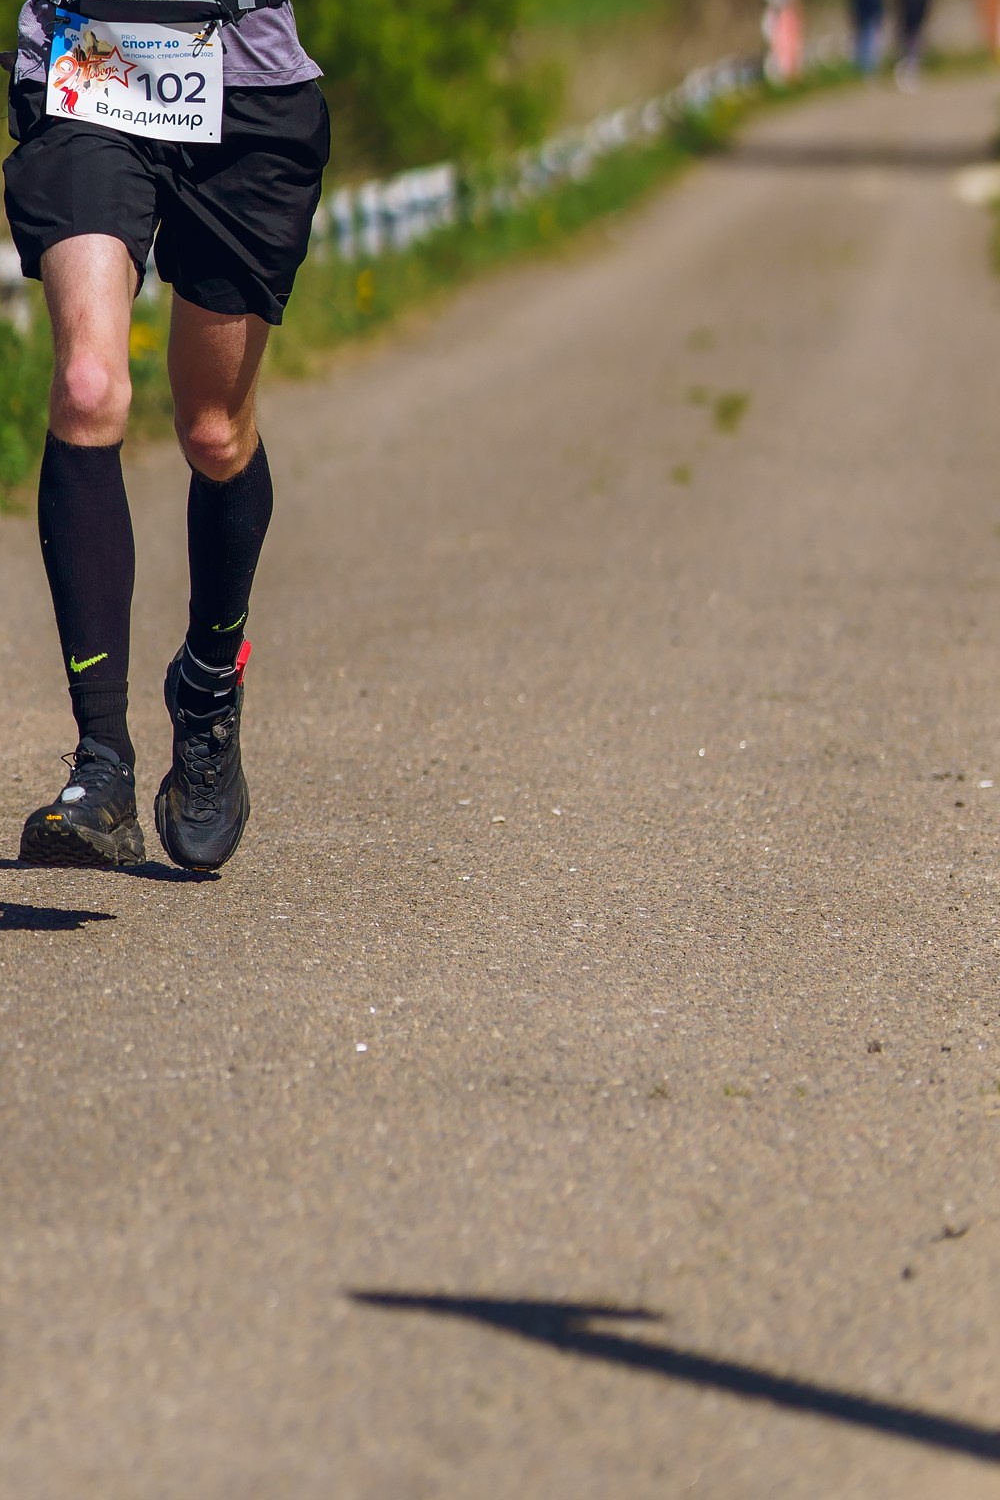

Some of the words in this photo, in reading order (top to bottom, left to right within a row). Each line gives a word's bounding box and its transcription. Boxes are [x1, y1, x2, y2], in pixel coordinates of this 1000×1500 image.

[122, 40, 162, 49] СПОРТ
[164, 40, 180, 49] 40
[136, 71, 206, 104] 102
[96, 101, 203, 130] Владимир
